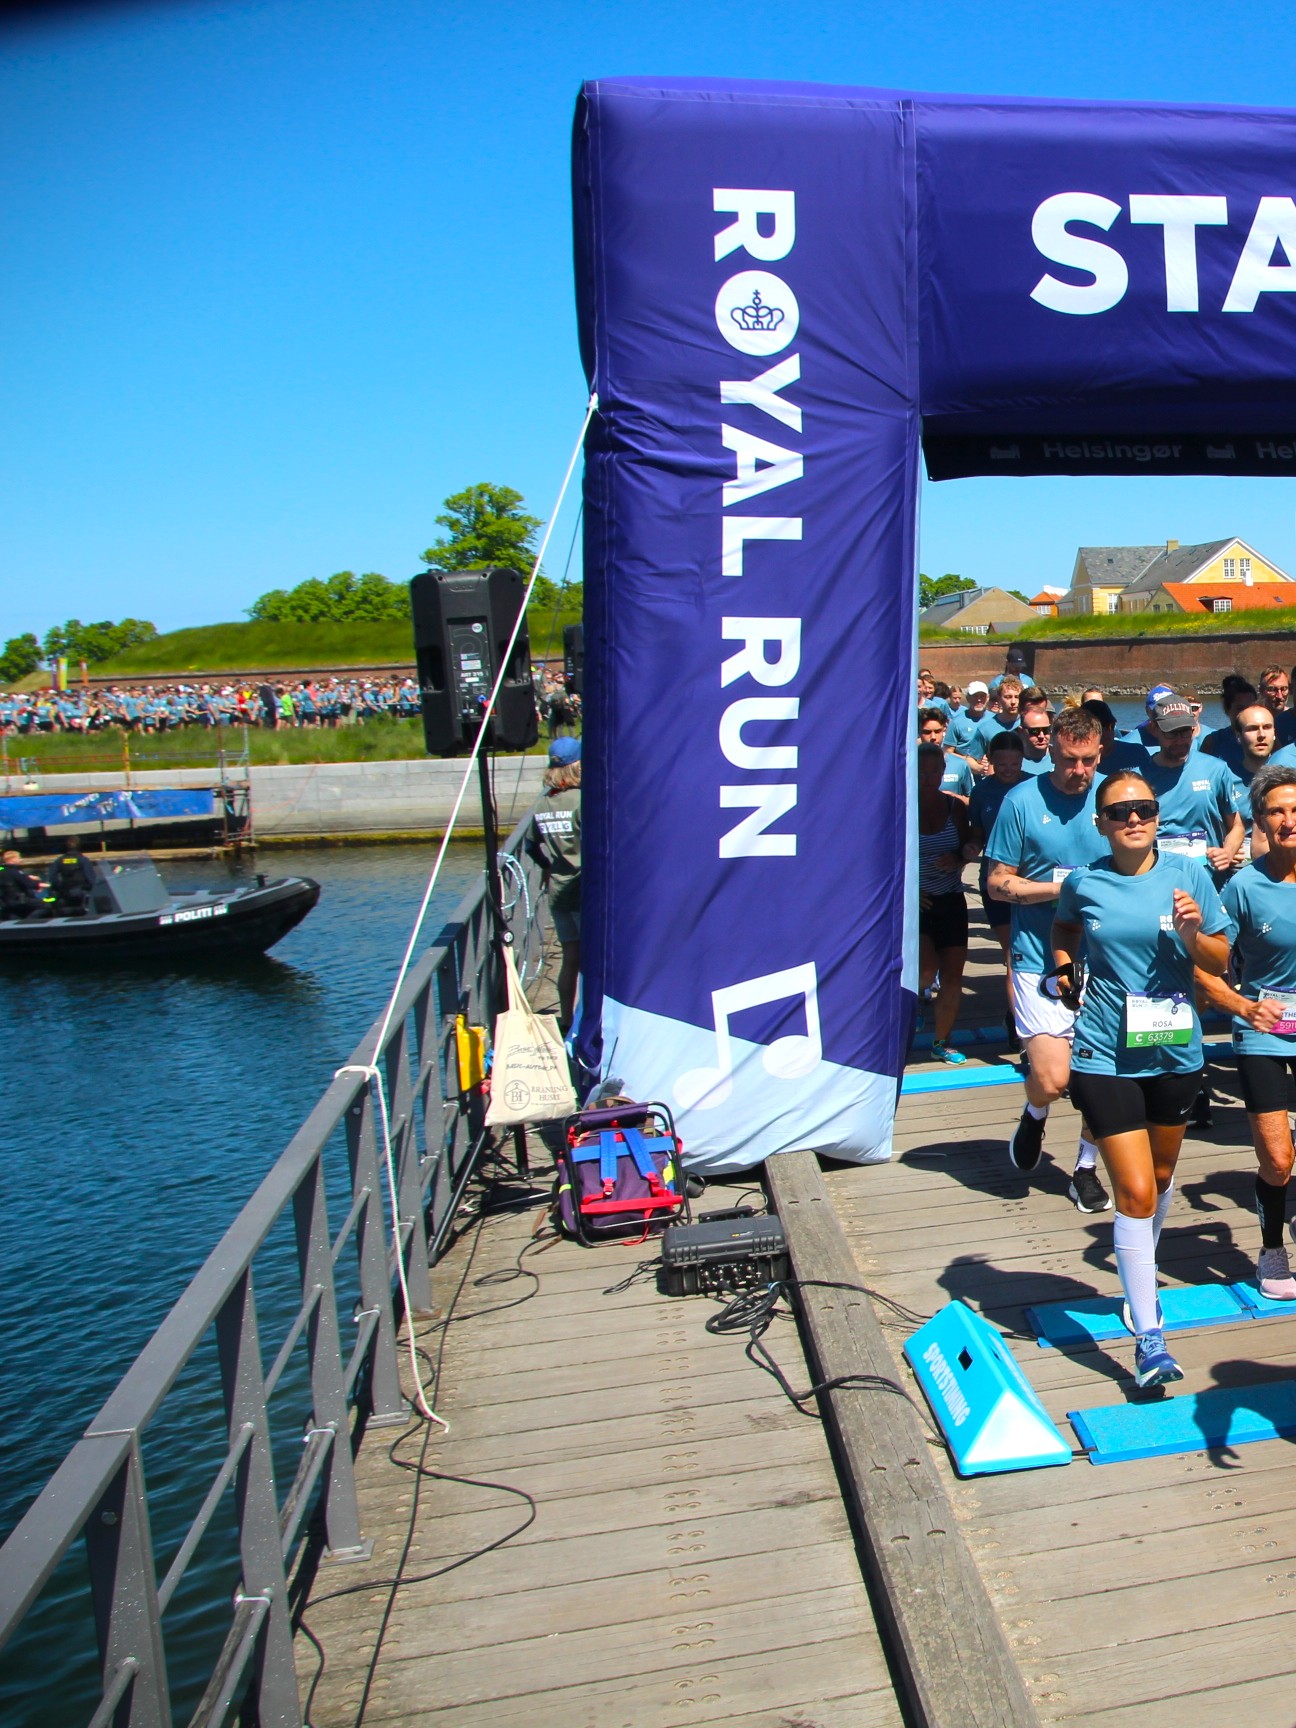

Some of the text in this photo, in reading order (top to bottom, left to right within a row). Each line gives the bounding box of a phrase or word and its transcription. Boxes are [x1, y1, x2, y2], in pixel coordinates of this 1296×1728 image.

[1042, 441, 1183, 462] Helsingør
[712, 187, 804, 859] ROYAL RUN
[1162, 702, 1191, 716] TALLINN
[555, 810, 573, 819] RUN
[174, 907, 213, 923] POLITI
[1152, 1020, 1173, 1028] ROSA
[1135, 1031, 1174, 1042] C 63379
[922, 1341, 971, 1427] SPORTSTIMING
